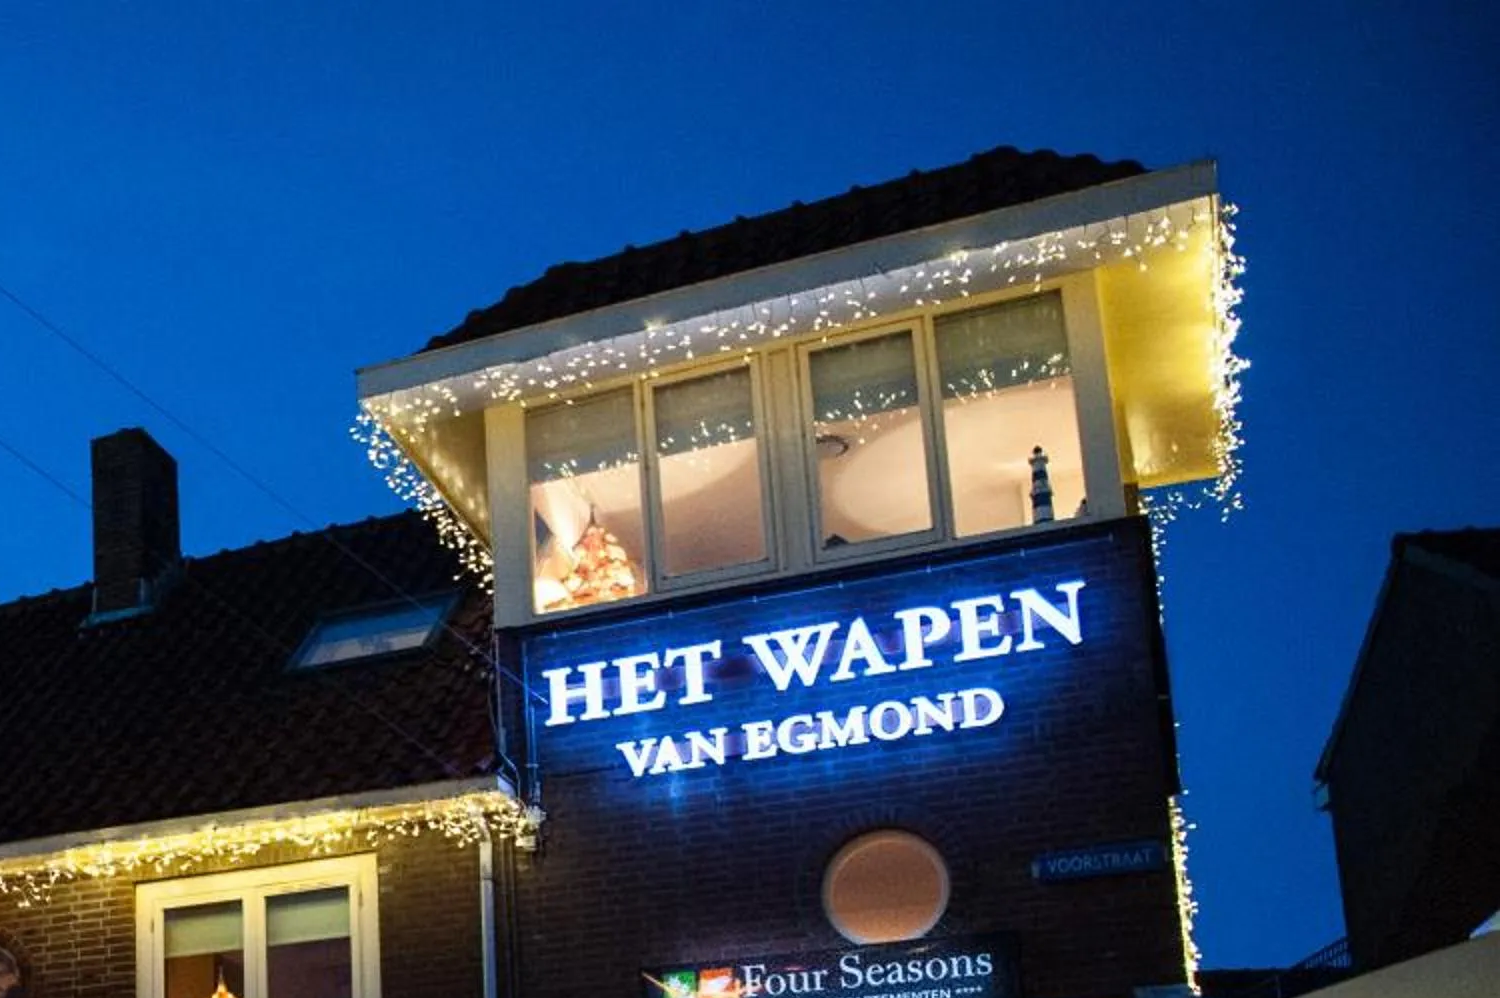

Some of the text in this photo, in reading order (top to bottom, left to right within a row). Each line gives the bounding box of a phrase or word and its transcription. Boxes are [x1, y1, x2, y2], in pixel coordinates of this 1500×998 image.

[543, 579, 1087, 727] HET WAPEN
[617, 686, 1005, 778] VAN EGMOND
[1047, 848, 1155, 874] VOORSTRAAT
[740, 951, 994, 998] Four Seasons
